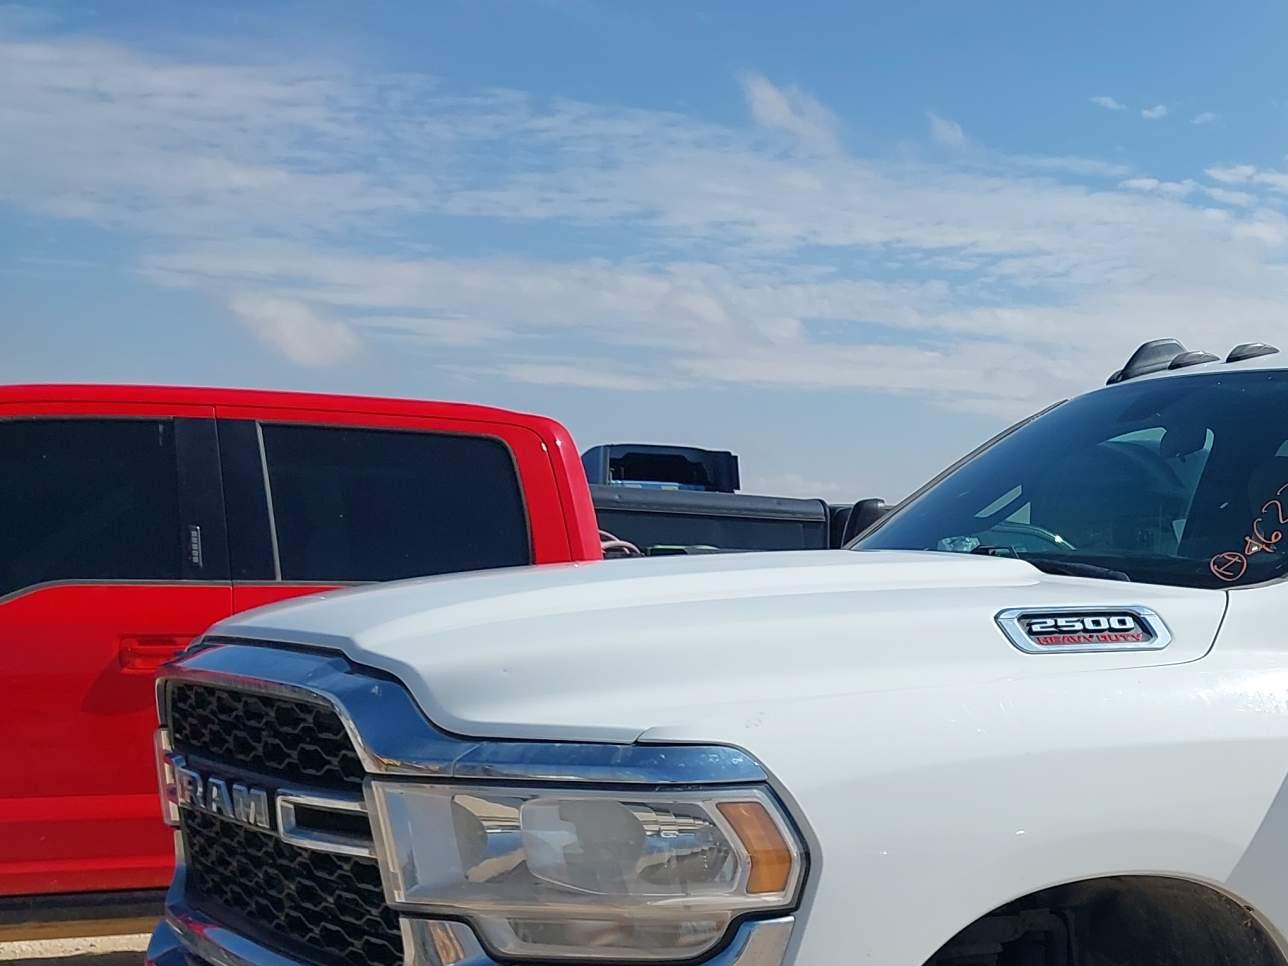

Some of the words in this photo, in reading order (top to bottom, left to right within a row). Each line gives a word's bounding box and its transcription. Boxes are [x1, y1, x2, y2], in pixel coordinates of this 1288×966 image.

[1031, 616, 1135, 633] 2500
[1036, 634, 1094, 646] HEAVY
[1097, 633, 1143, 643] DUTY
[174, 766, 270, 829] RAM
